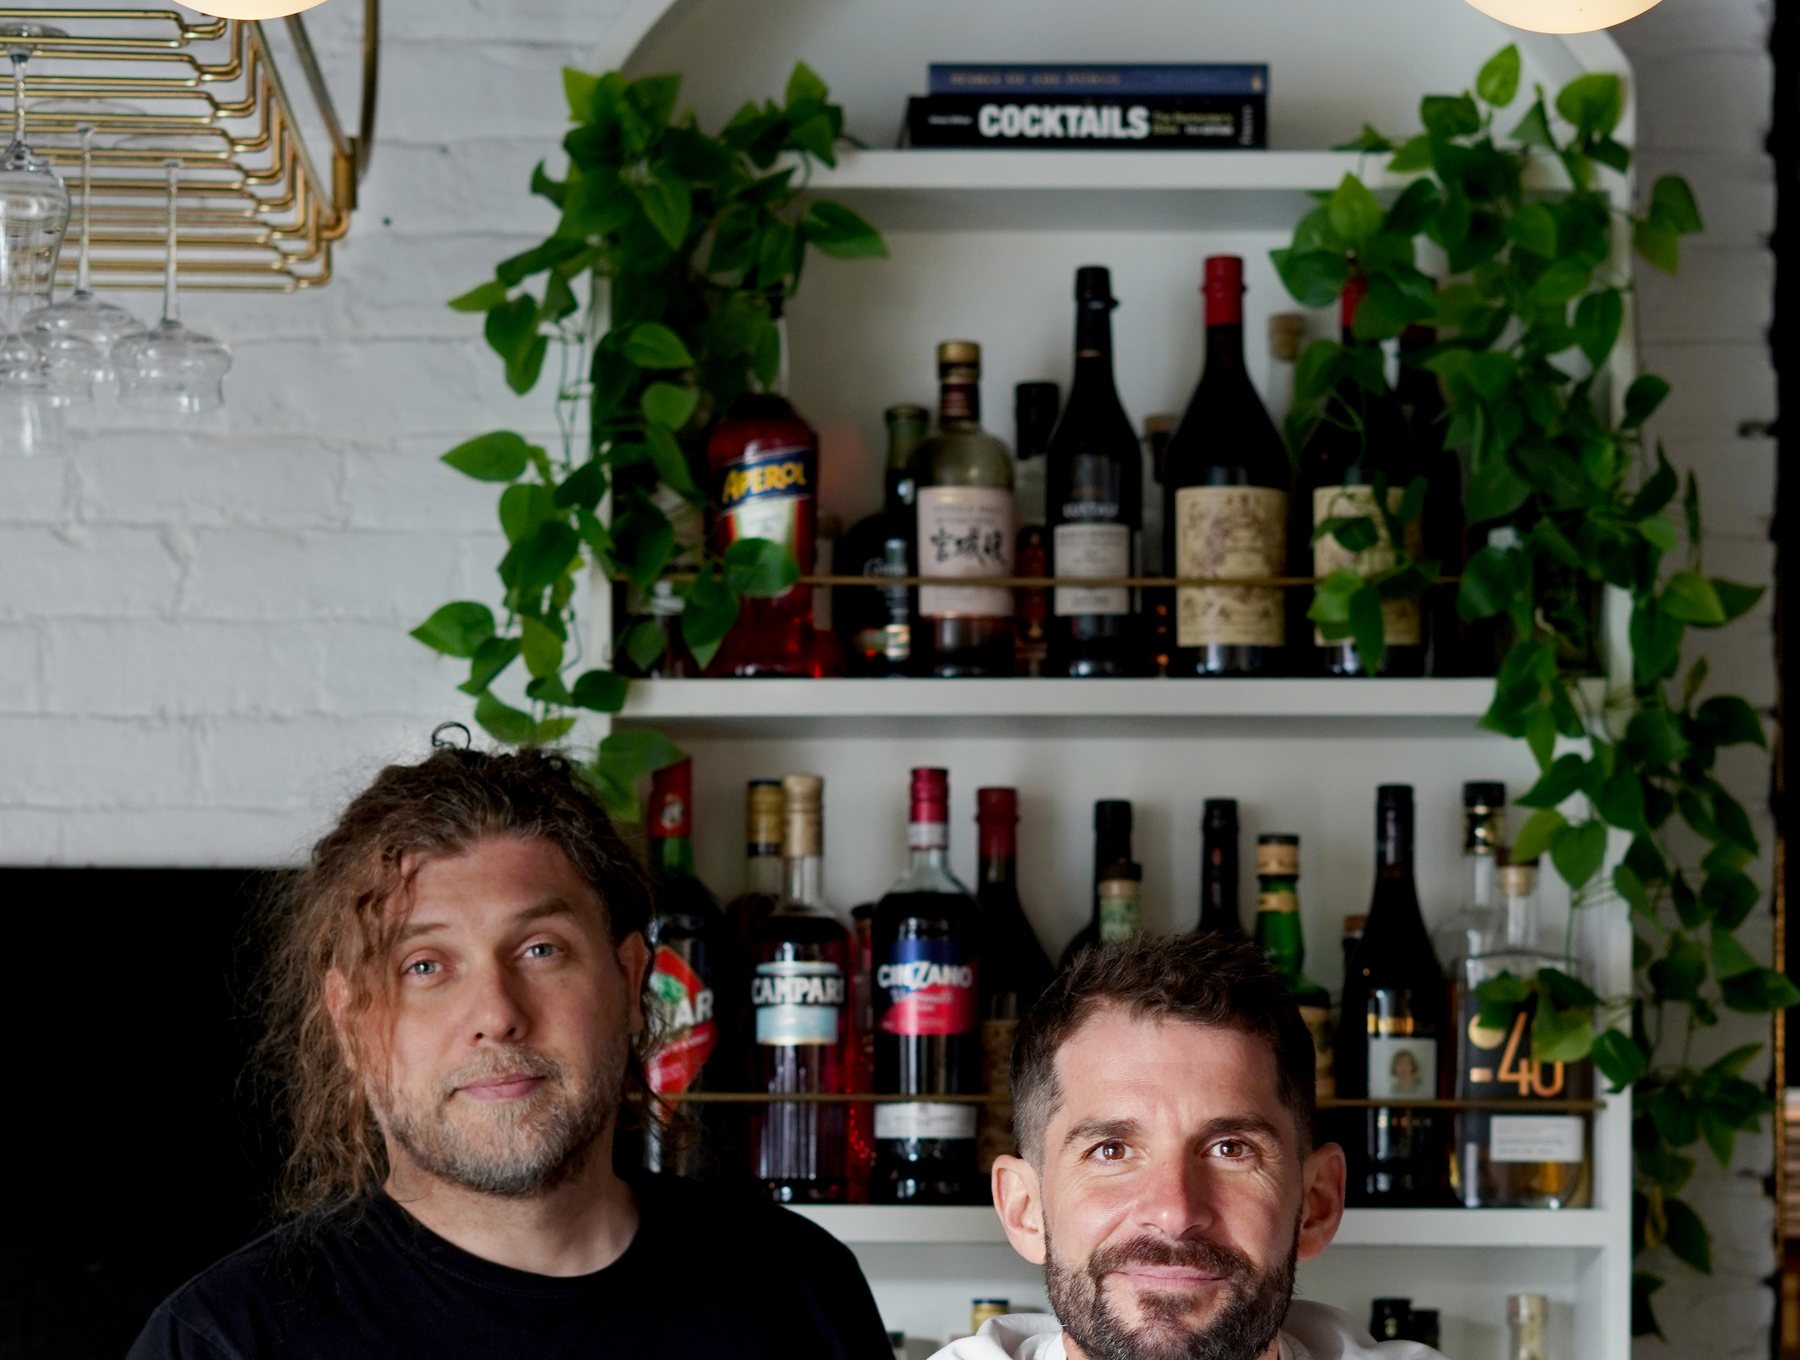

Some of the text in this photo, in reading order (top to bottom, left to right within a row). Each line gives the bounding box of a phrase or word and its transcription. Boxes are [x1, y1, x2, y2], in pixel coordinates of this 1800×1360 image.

[978, 104, 1150, 139] COCKTAILS
[721, 461, 807, 504] APEROL
[751, 975, 845, 1005] CAMPARI
[877, 960, 973, 992] CINZANO
